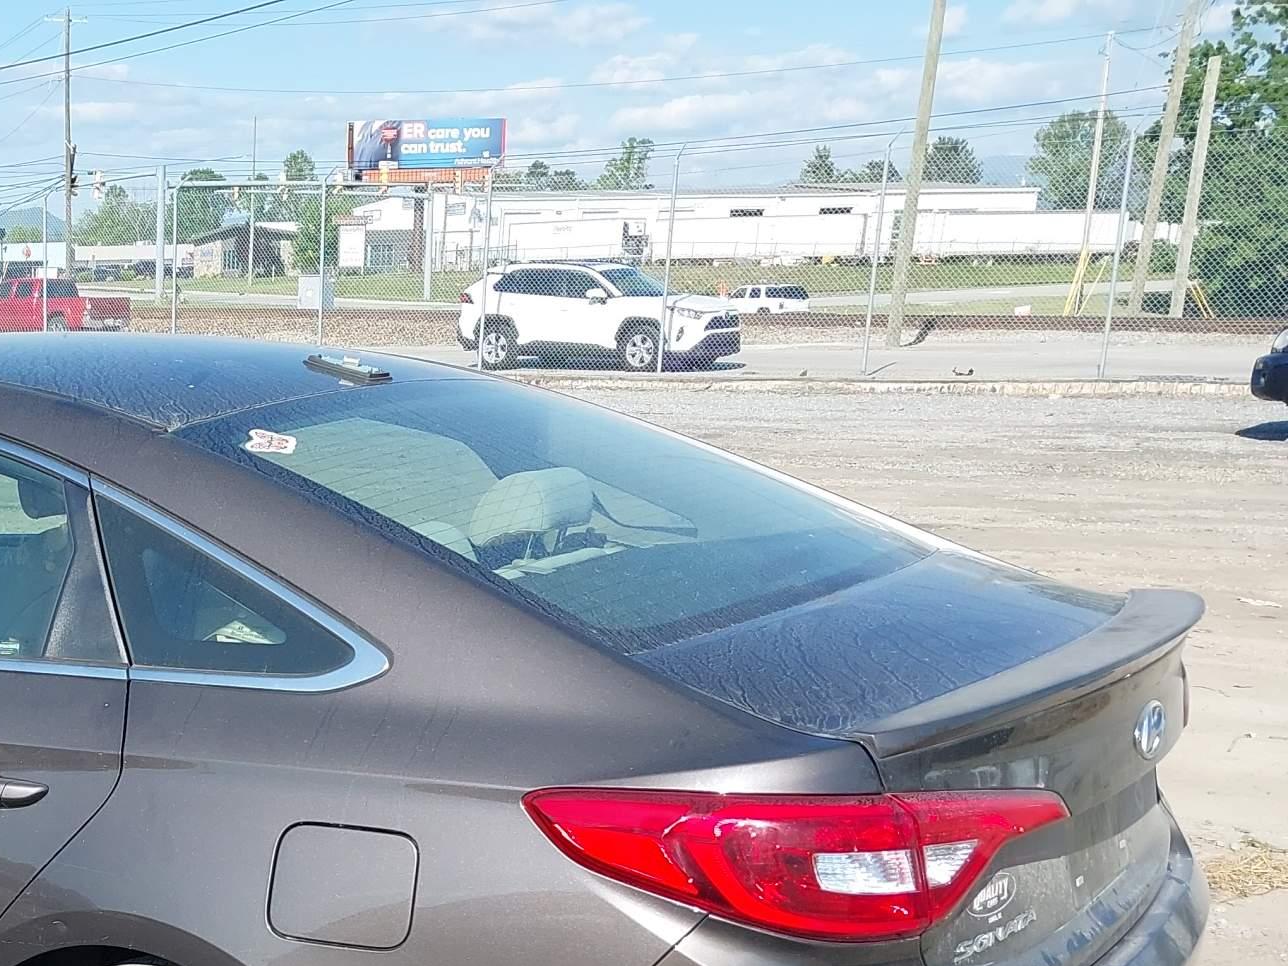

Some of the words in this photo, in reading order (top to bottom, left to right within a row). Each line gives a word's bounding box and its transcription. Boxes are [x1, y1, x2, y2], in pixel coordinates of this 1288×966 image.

[403, 122, 426, 139] ER
[428, 128, 460, 139] care
[463, 127, 491, 141] you
[401, 142, 427, 153] can
[428, 140, 466, 153] trust.
[973, 876, 1009, 911] QUALITY
[953, 909, 1037, 965] SONATA
